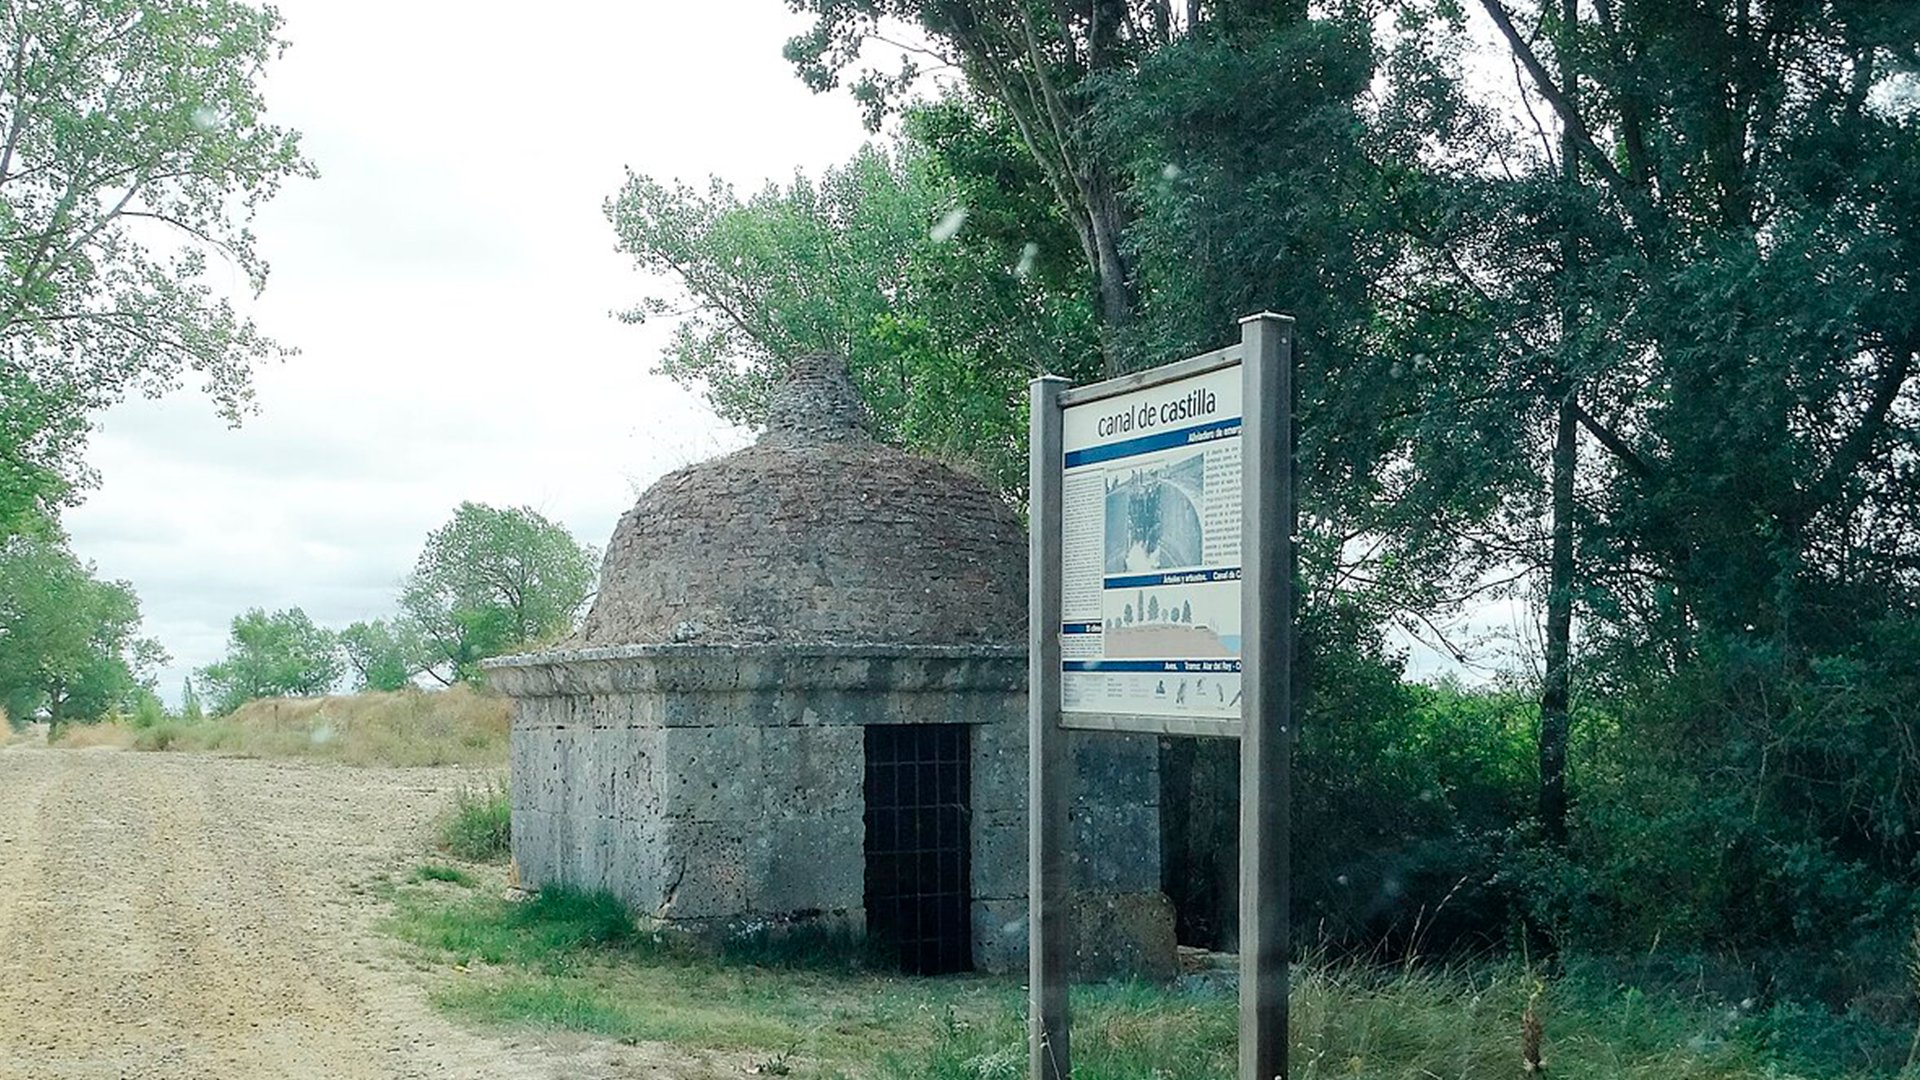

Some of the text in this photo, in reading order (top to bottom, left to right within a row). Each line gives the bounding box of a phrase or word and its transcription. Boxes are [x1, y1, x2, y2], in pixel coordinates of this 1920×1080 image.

[1098, 388, 1216, 437] canal de castilla
[1213, 570, 1228, 580] Canal
[1229, 570, 1235, 580] de
[1202, 661, 1213, 670] Alar
[1213, 661, 1221, 670] del
[1222, 661, 1232, 672] Rey
